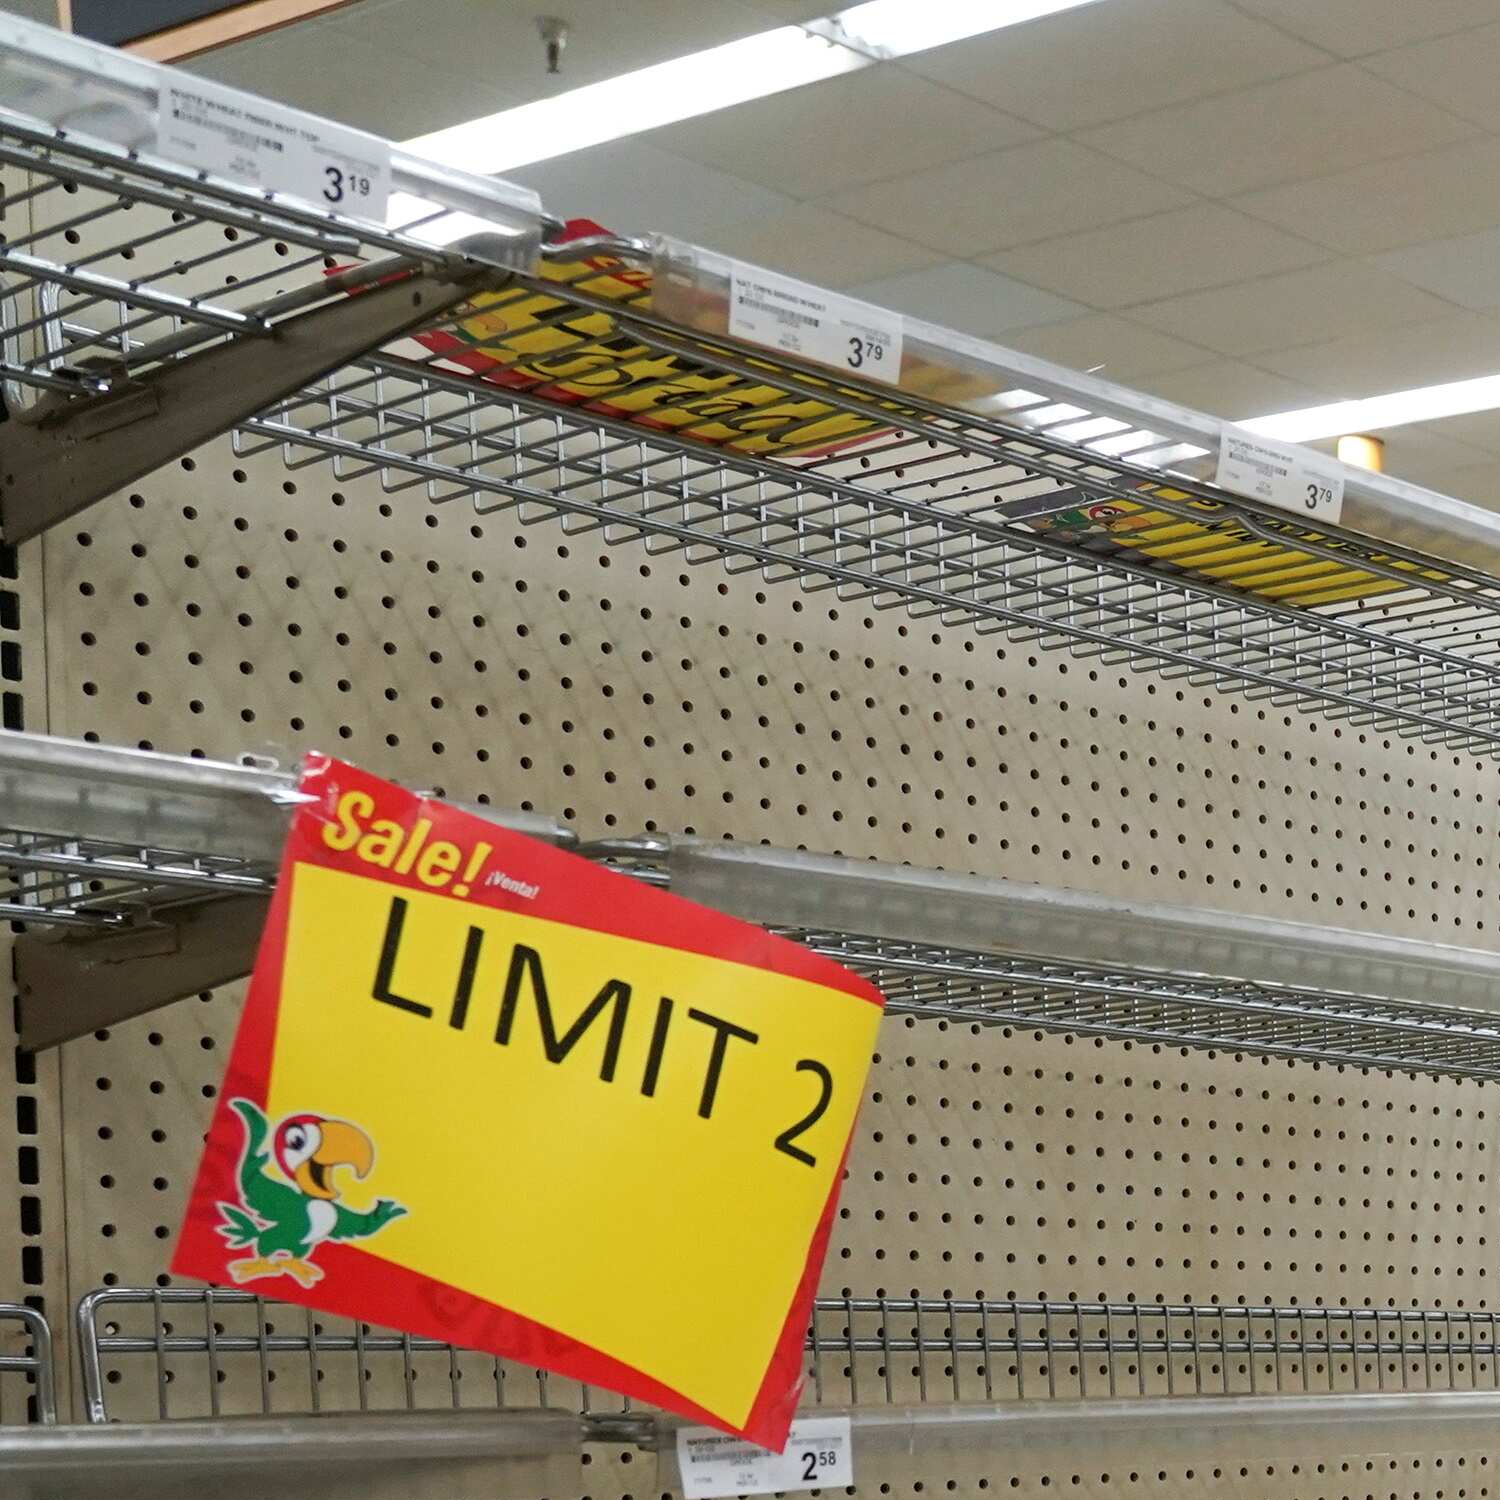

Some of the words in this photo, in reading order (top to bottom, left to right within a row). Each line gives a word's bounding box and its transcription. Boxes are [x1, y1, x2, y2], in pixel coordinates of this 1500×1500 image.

[321, 790, 493, 897] Sale!
[371, 896, 760, 1121] LIMIT
[773, 1057, 835, 1169] 2
[801, 1451, 837, 1481] 258
